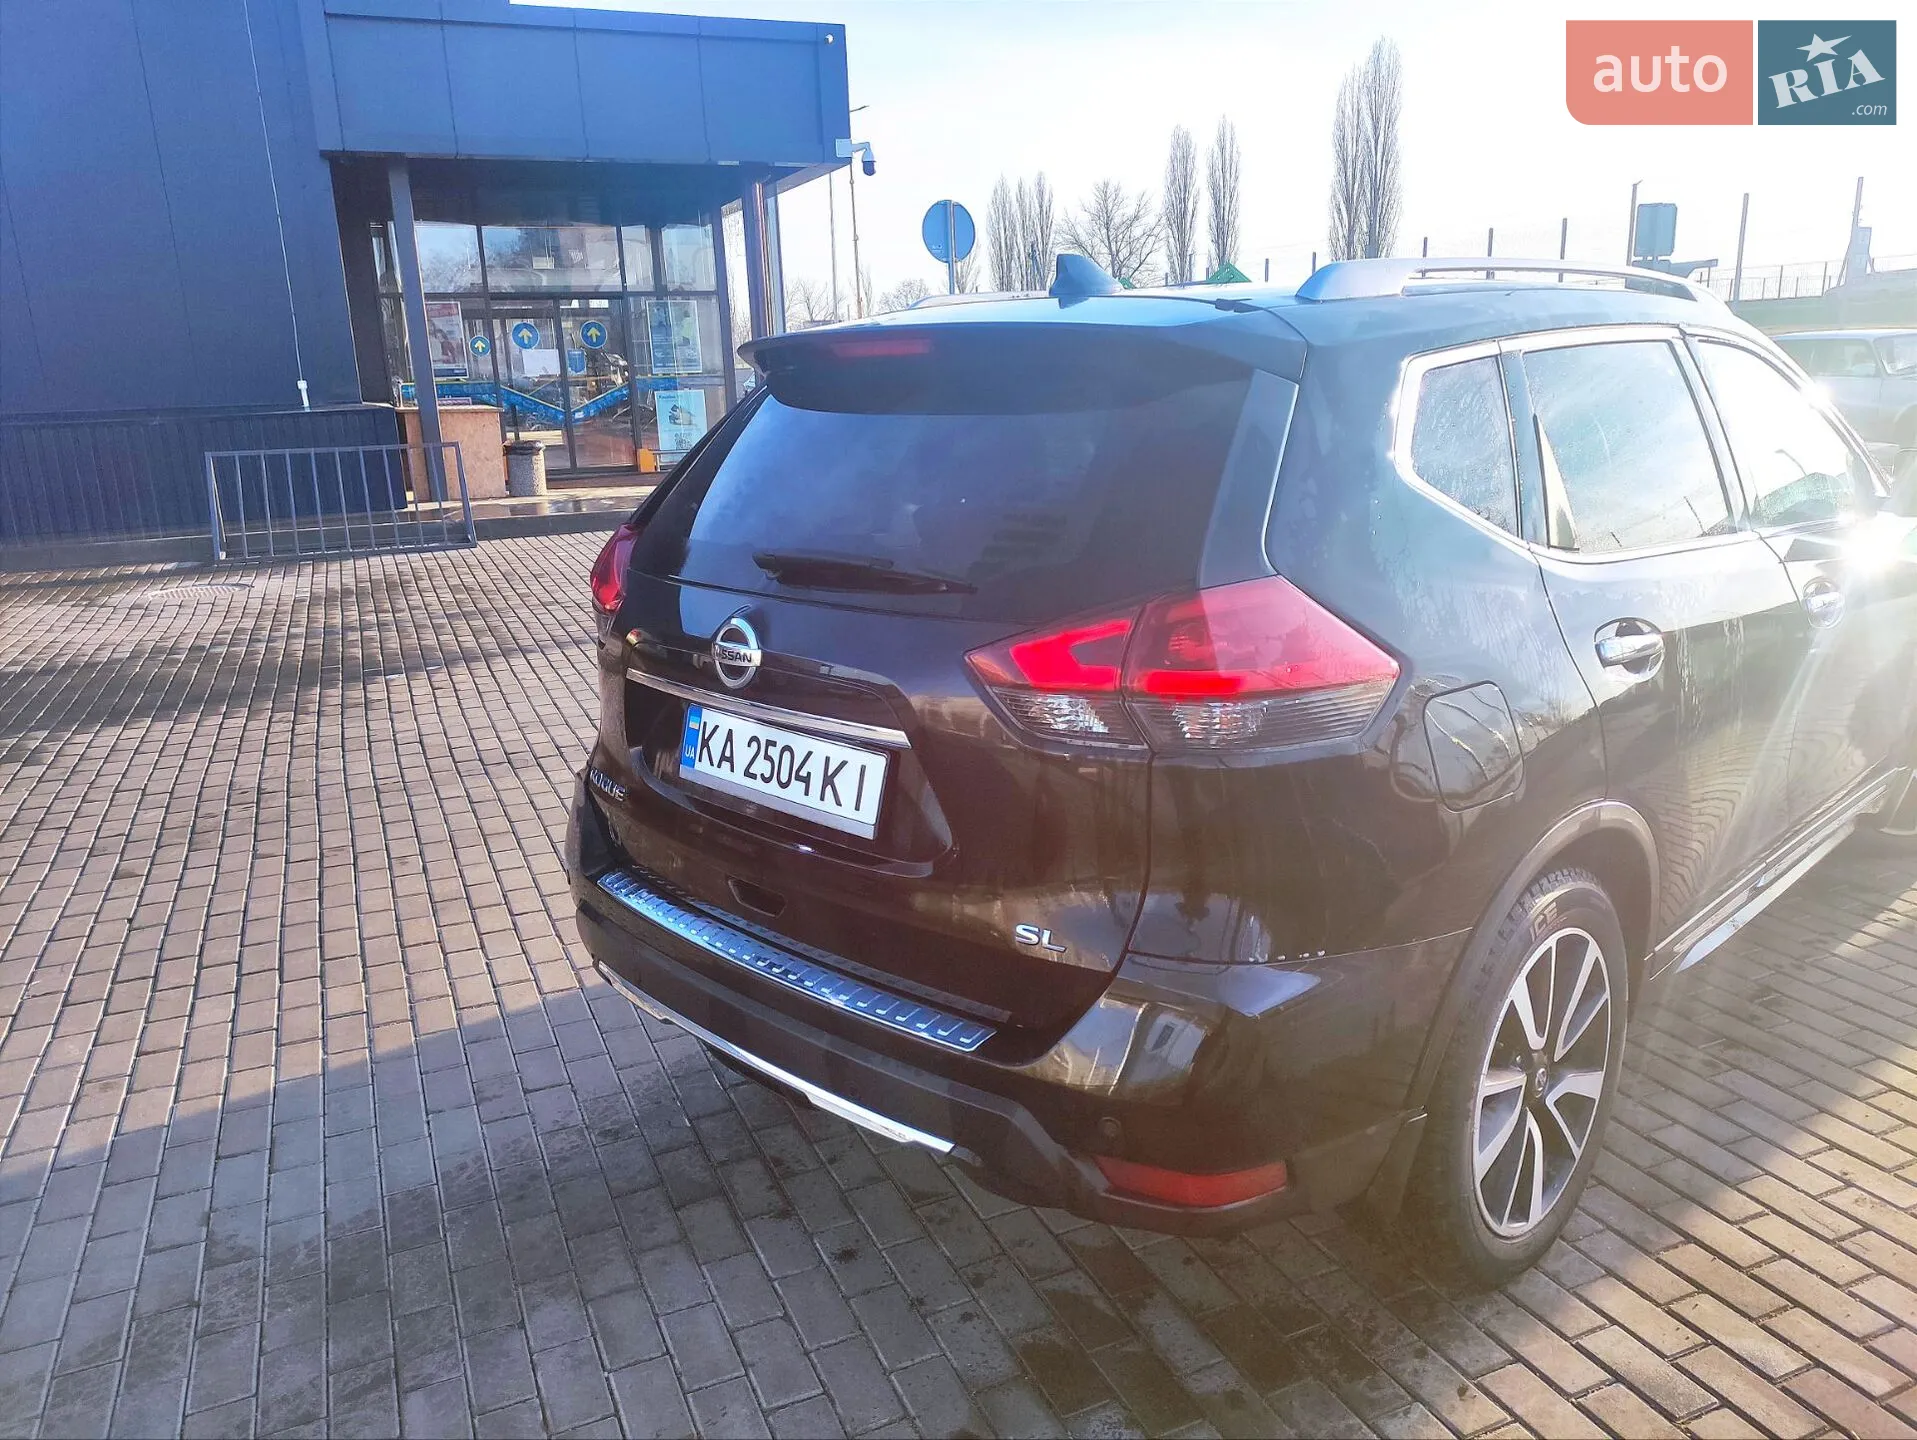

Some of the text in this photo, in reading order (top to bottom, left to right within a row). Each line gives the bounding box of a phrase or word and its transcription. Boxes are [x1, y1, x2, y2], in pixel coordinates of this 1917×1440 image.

[684, 744, 696, 760] UA
[698, 721, 735, 773] KA
[743, 735, 814, 797] 2504
[1015, 923, 1067, 953] SL
[1529, 901, 1558, 943] ICE
